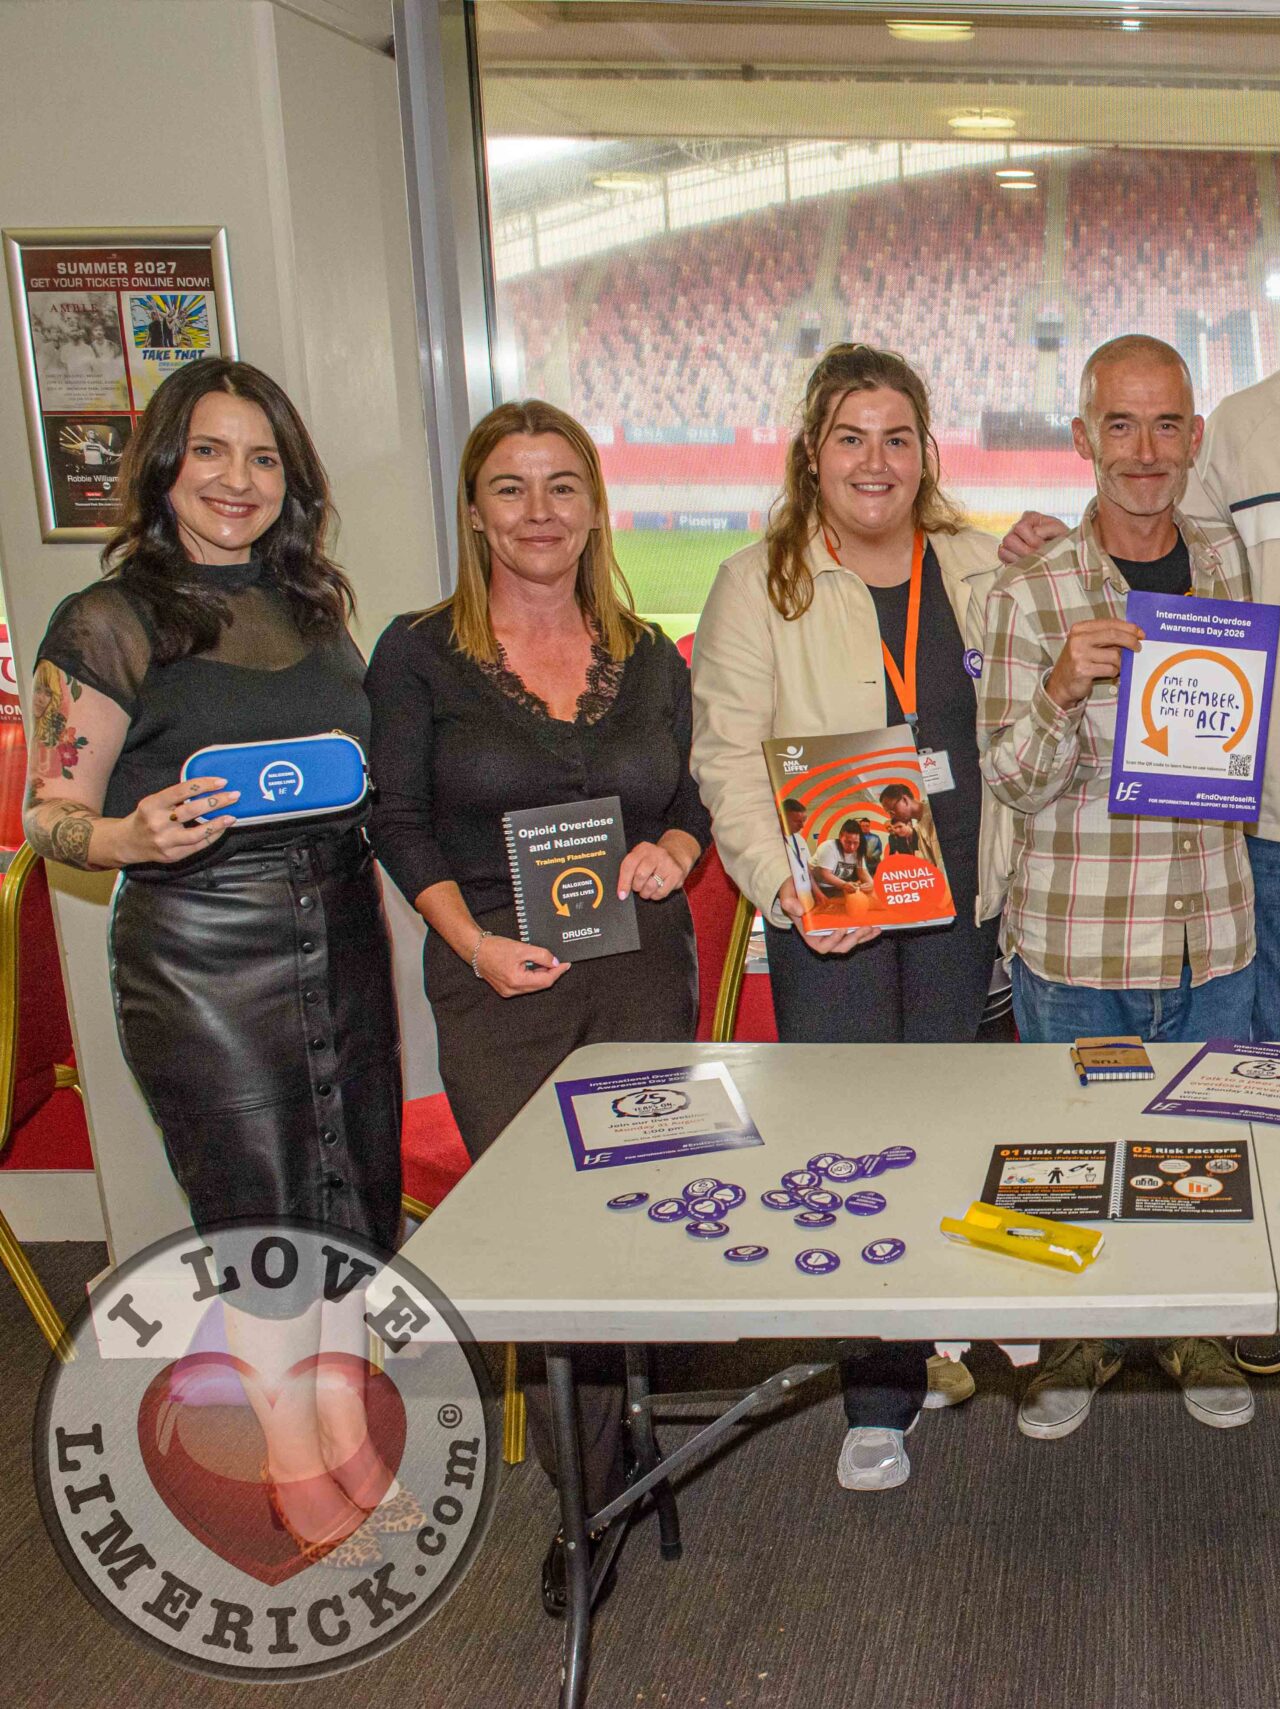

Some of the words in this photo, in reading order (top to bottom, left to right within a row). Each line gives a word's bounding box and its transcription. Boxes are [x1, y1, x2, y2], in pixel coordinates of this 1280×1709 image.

[56, 262, 128, 274] SUMMER
[134, 262, 177, 274] 2027
[30, 278, 51, 288] GET
[53, 278, 83, 288] YOUR
[85, 278, 129, 287] TICKETS
[131, 277, 174, 287] ONLINE
[176, 277, 210, 287] NOW!
[142, 350, 170, 361] TAKE
[174, 349, 205, 361] THAT
[679, 515, 729, 531] Pinergy
[1156, 610, 1210, 624] International
[1212, 615, 1252, 627] Overdose
[1160, 622, 1205, 635] Awareness
[1206, 627, 1223, 637] Day
[1224, 628, 1245, 638] 2026
[1163, 675, 1184, 687] TIME
[1187, 677, 1199, 688] TO
[1161, 688, 1240, 710] REMEMBER.
[1159, 705, 1180, 717] TIME
[1184, 708, 1195, 718] TO
[1196, 710, 1236, 732] ACT.
[518, 824, 557, 839] Opioid
[559, 816, 614, 832] Overdose
[529, 842, 551, 853] and
[554, 833, 608, 849] Naloxone
[536, 857, 565, 866] Training
[567, 850, 606, 862] Flashcards
[881, 866, 934, 882] ANNUAL
[562, 879, 593, 889] NALOXONE
[883, 878, 936, 893] REPORT
[562, 891, 579, 899] SAVES
[887, 892, 920, 905] 2025
[1235, 1049, 1279, 1057] Awareness
[589, 1076, 650, 1087] International
[597, 1082, 647, 1090] Awareness
[1190, 1081, 1242, 1089] overdose
[634, 1093, 666, 1104] 25
[615, 1126, 655, 1134] Monday
